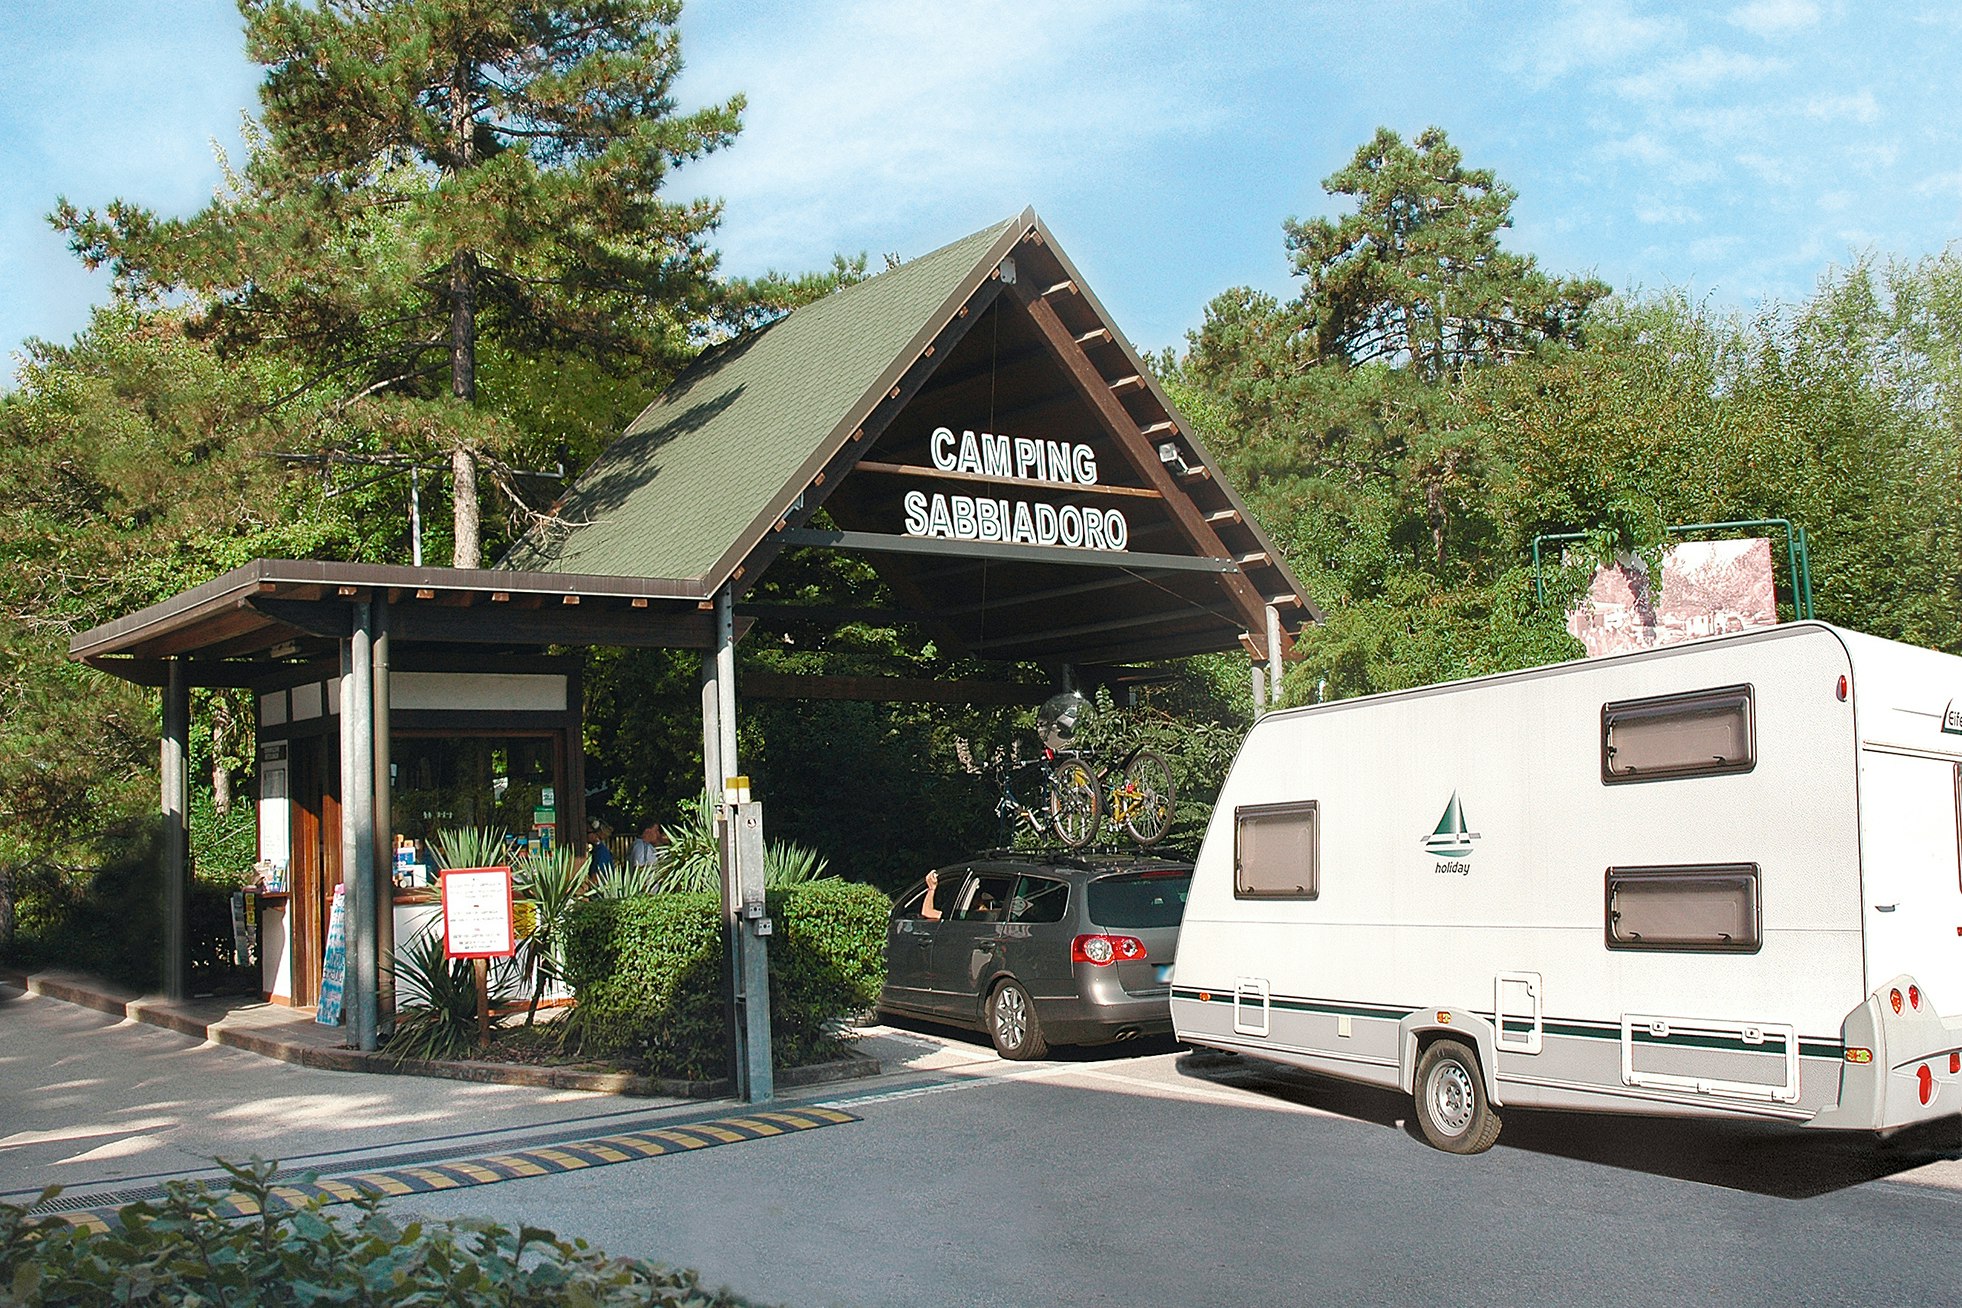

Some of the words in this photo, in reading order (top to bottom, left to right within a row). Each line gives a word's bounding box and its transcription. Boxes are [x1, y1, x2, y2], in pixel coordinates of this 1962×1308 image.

[930, 427, 1097, 485] CAMPING
[904, 491, 1128, 550] SABBIADORO
[1435, 861, 1470, 876] holiday
